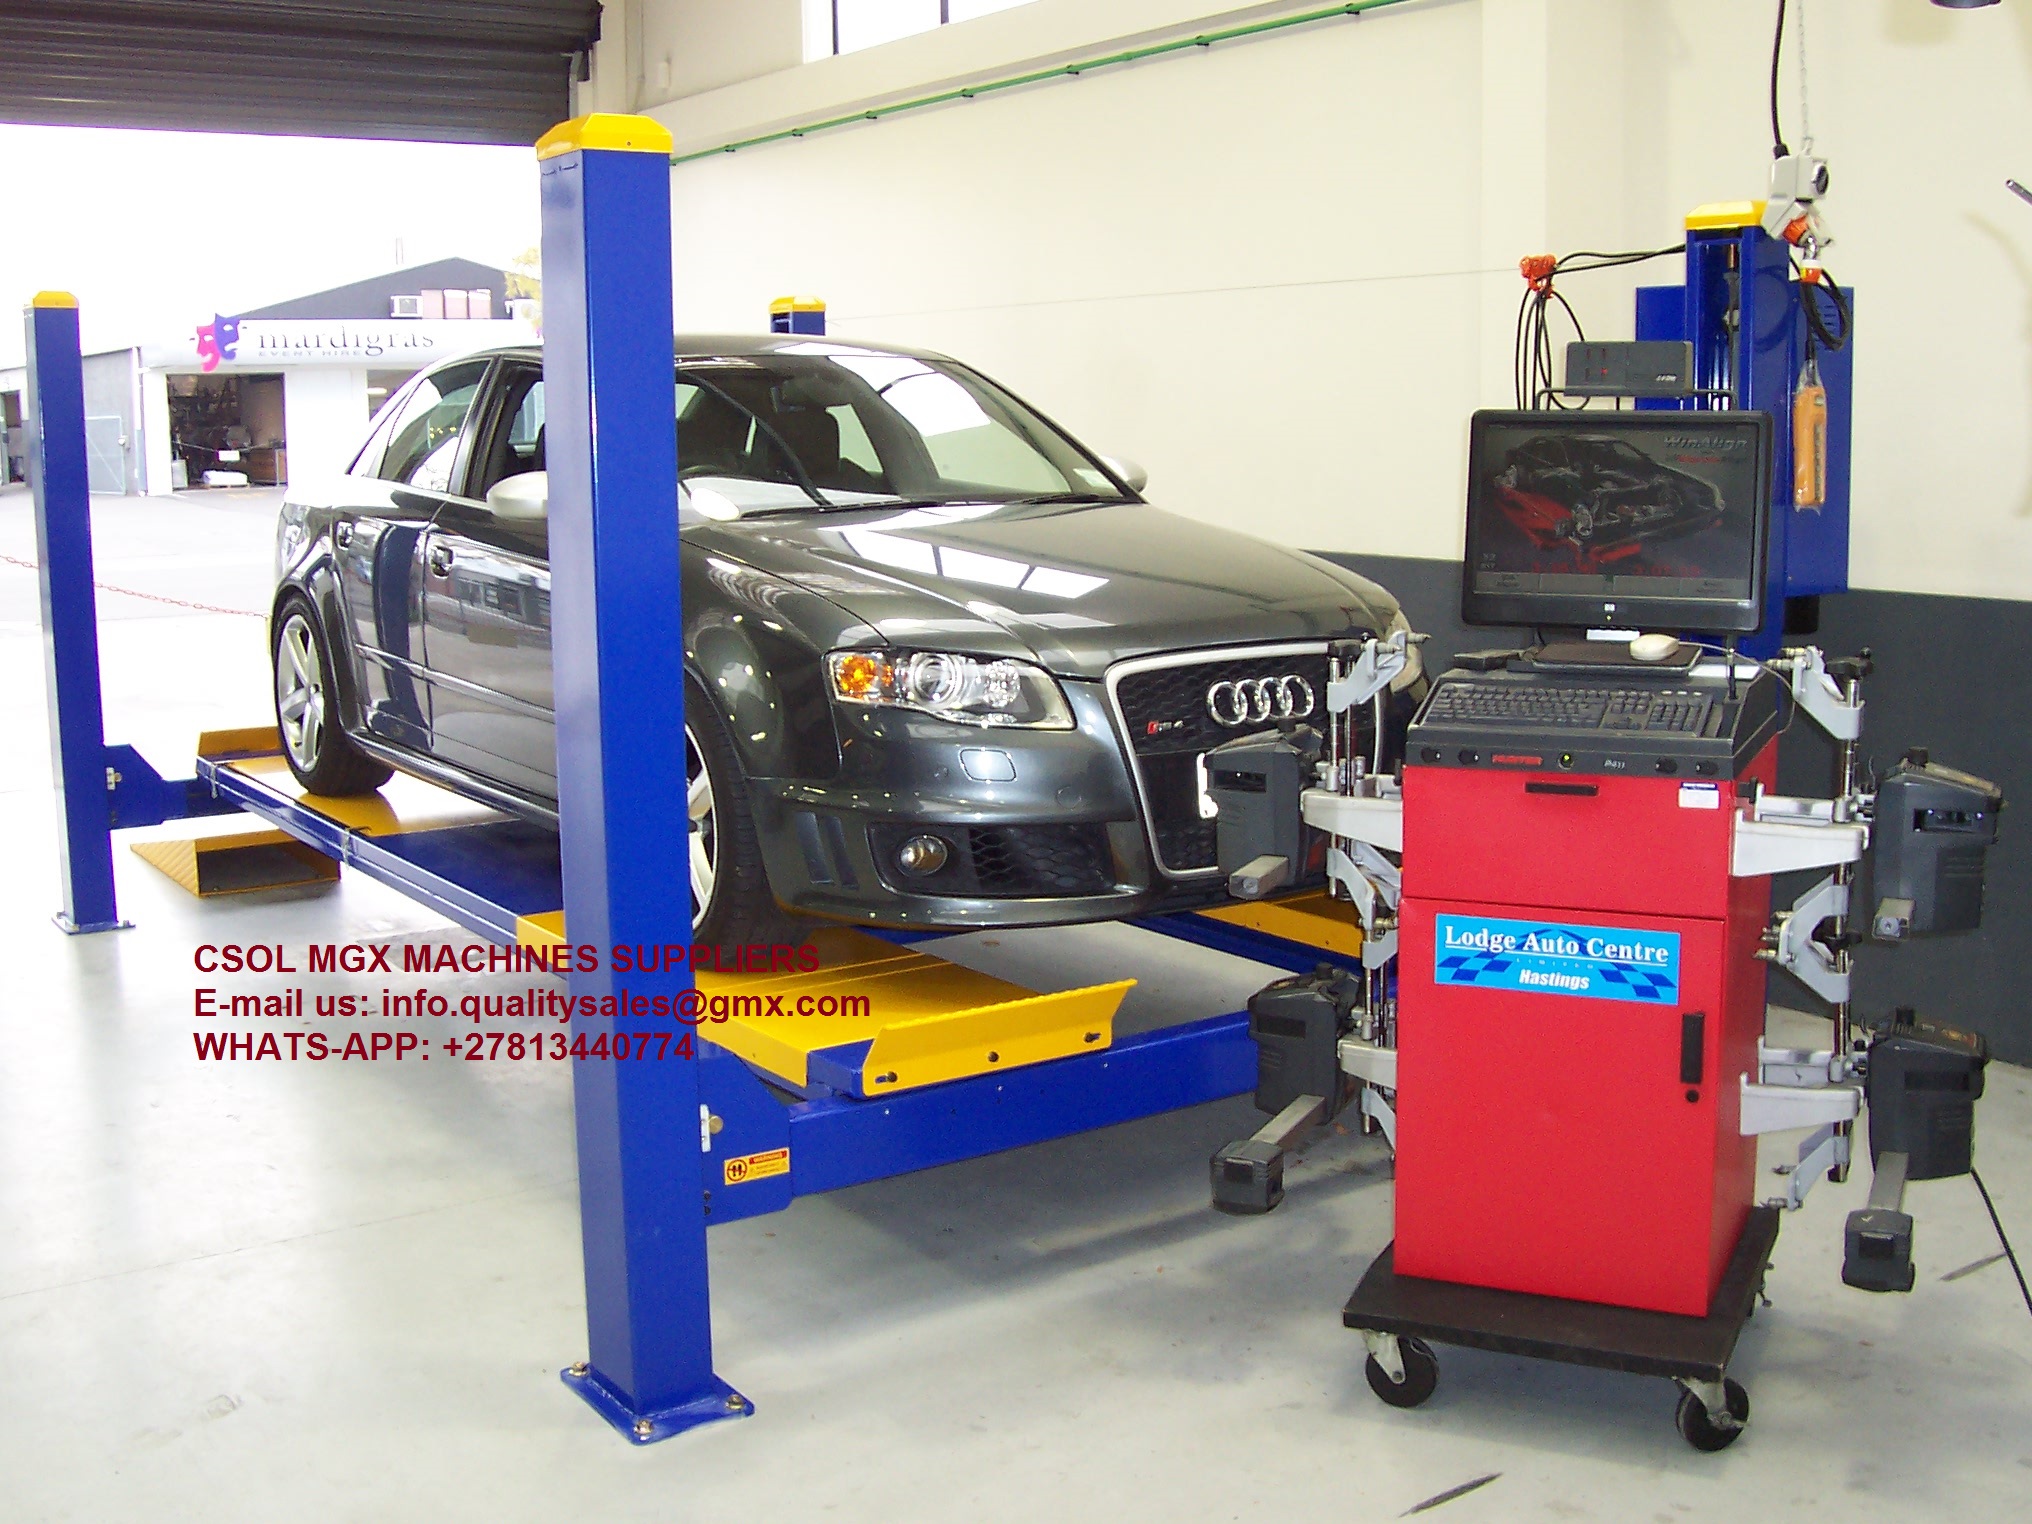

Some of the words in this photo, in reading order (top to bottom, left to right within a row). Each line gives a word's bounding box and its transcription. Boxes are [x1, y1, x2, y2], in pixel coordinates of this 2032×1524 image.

[259, 326, 434, 356] mardigras
[1445, 925, 1516, 954] Lodge
[1522, 933, 1579, 956] Auto
[1586, 937, 1669, 963] Centre
[1519, 968, 1590, 990] Hastings
